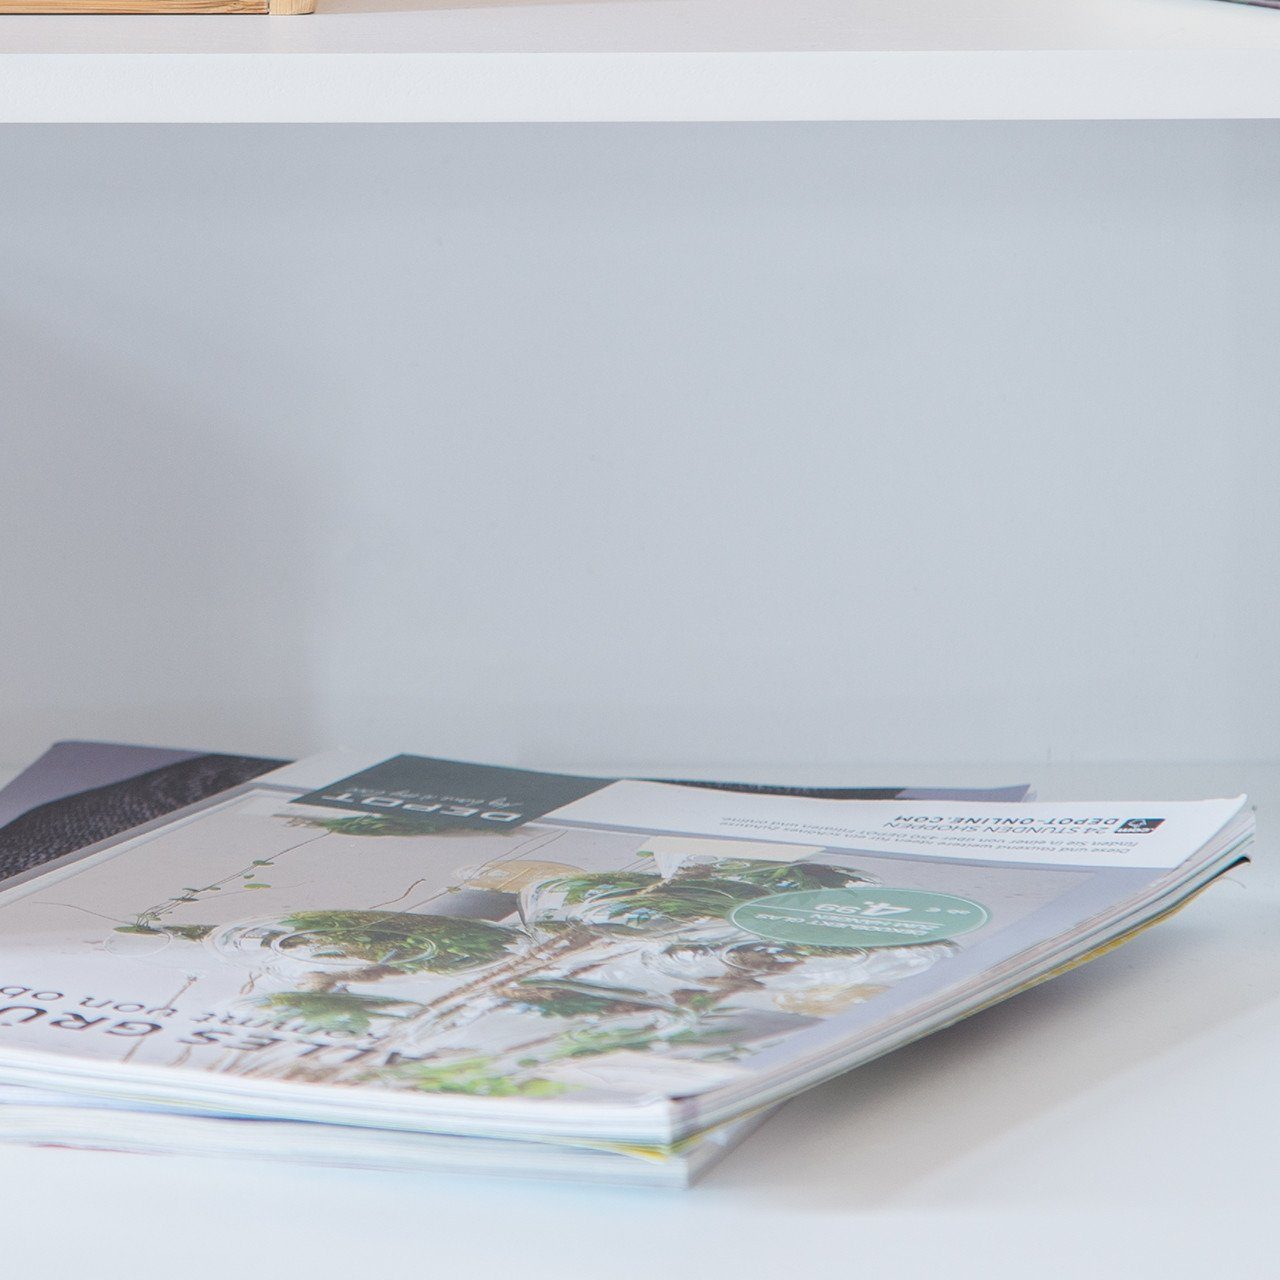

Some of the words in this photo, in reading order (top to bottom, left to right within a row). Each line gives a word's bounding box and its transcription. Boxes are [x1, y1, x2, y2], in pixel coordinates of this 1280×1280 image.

[320, 793, 522, 822] DEPOT
[893, 816, 1119, 825] DEPOT-ONLINE.COM
[882, 822, 981, 833] SHOPPEN
[982, 826, 1082, 834] STUNDEN
[79, 998, 178, 1019] von
